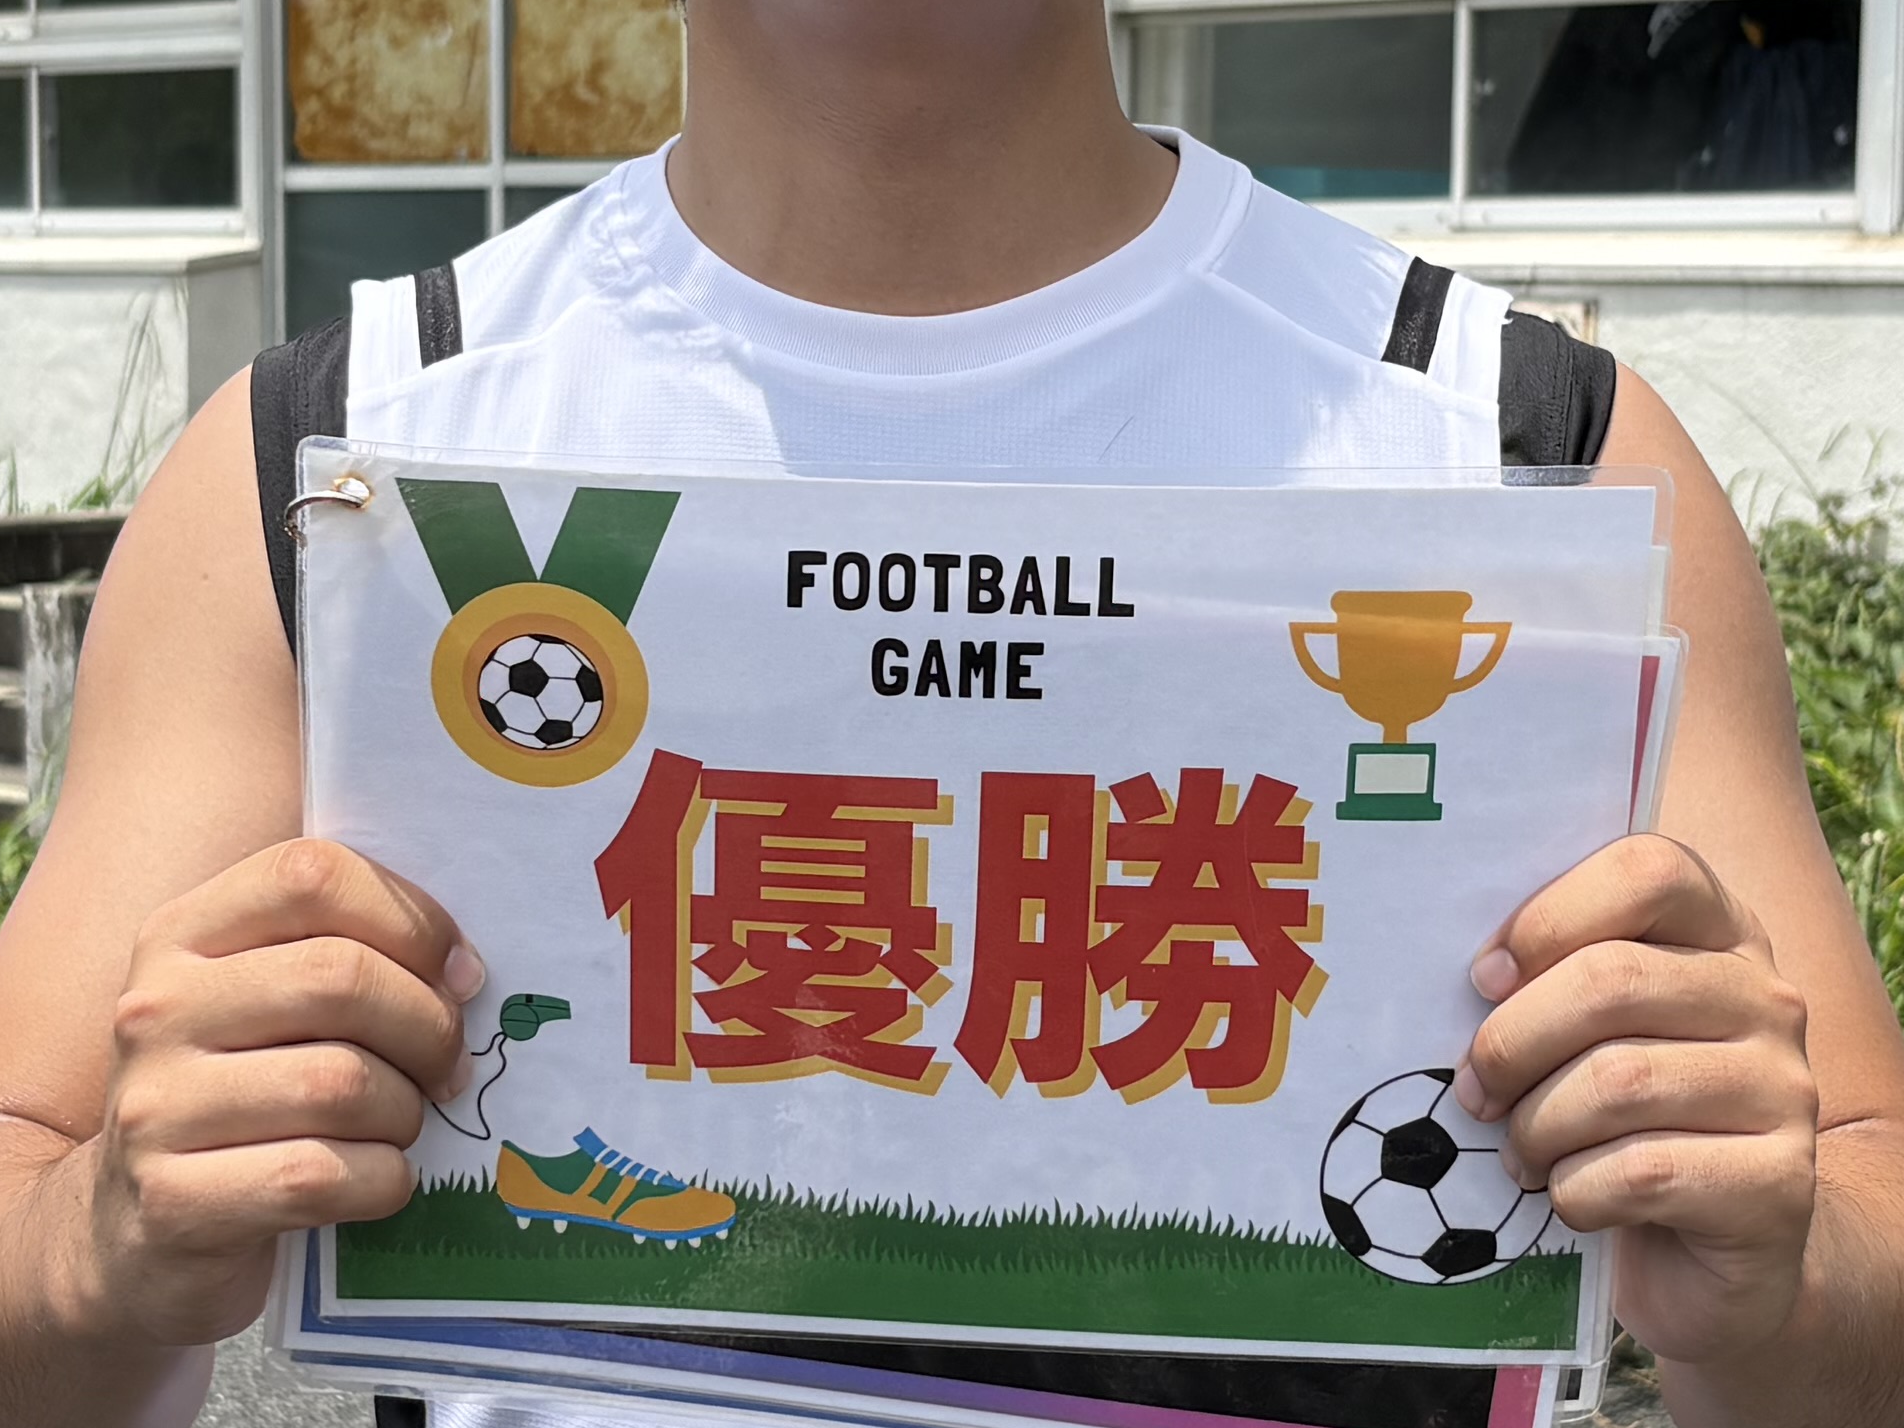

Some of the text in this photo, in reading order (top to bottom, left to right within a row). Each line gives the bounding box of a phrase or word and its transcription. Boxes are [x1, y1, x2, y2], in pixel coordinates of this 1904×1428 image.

[786, 550, 1135, 618] FOOTBALL
[870, 637, 1045, 700] GAME
[593, 747, 1330, 1106] 優勝
